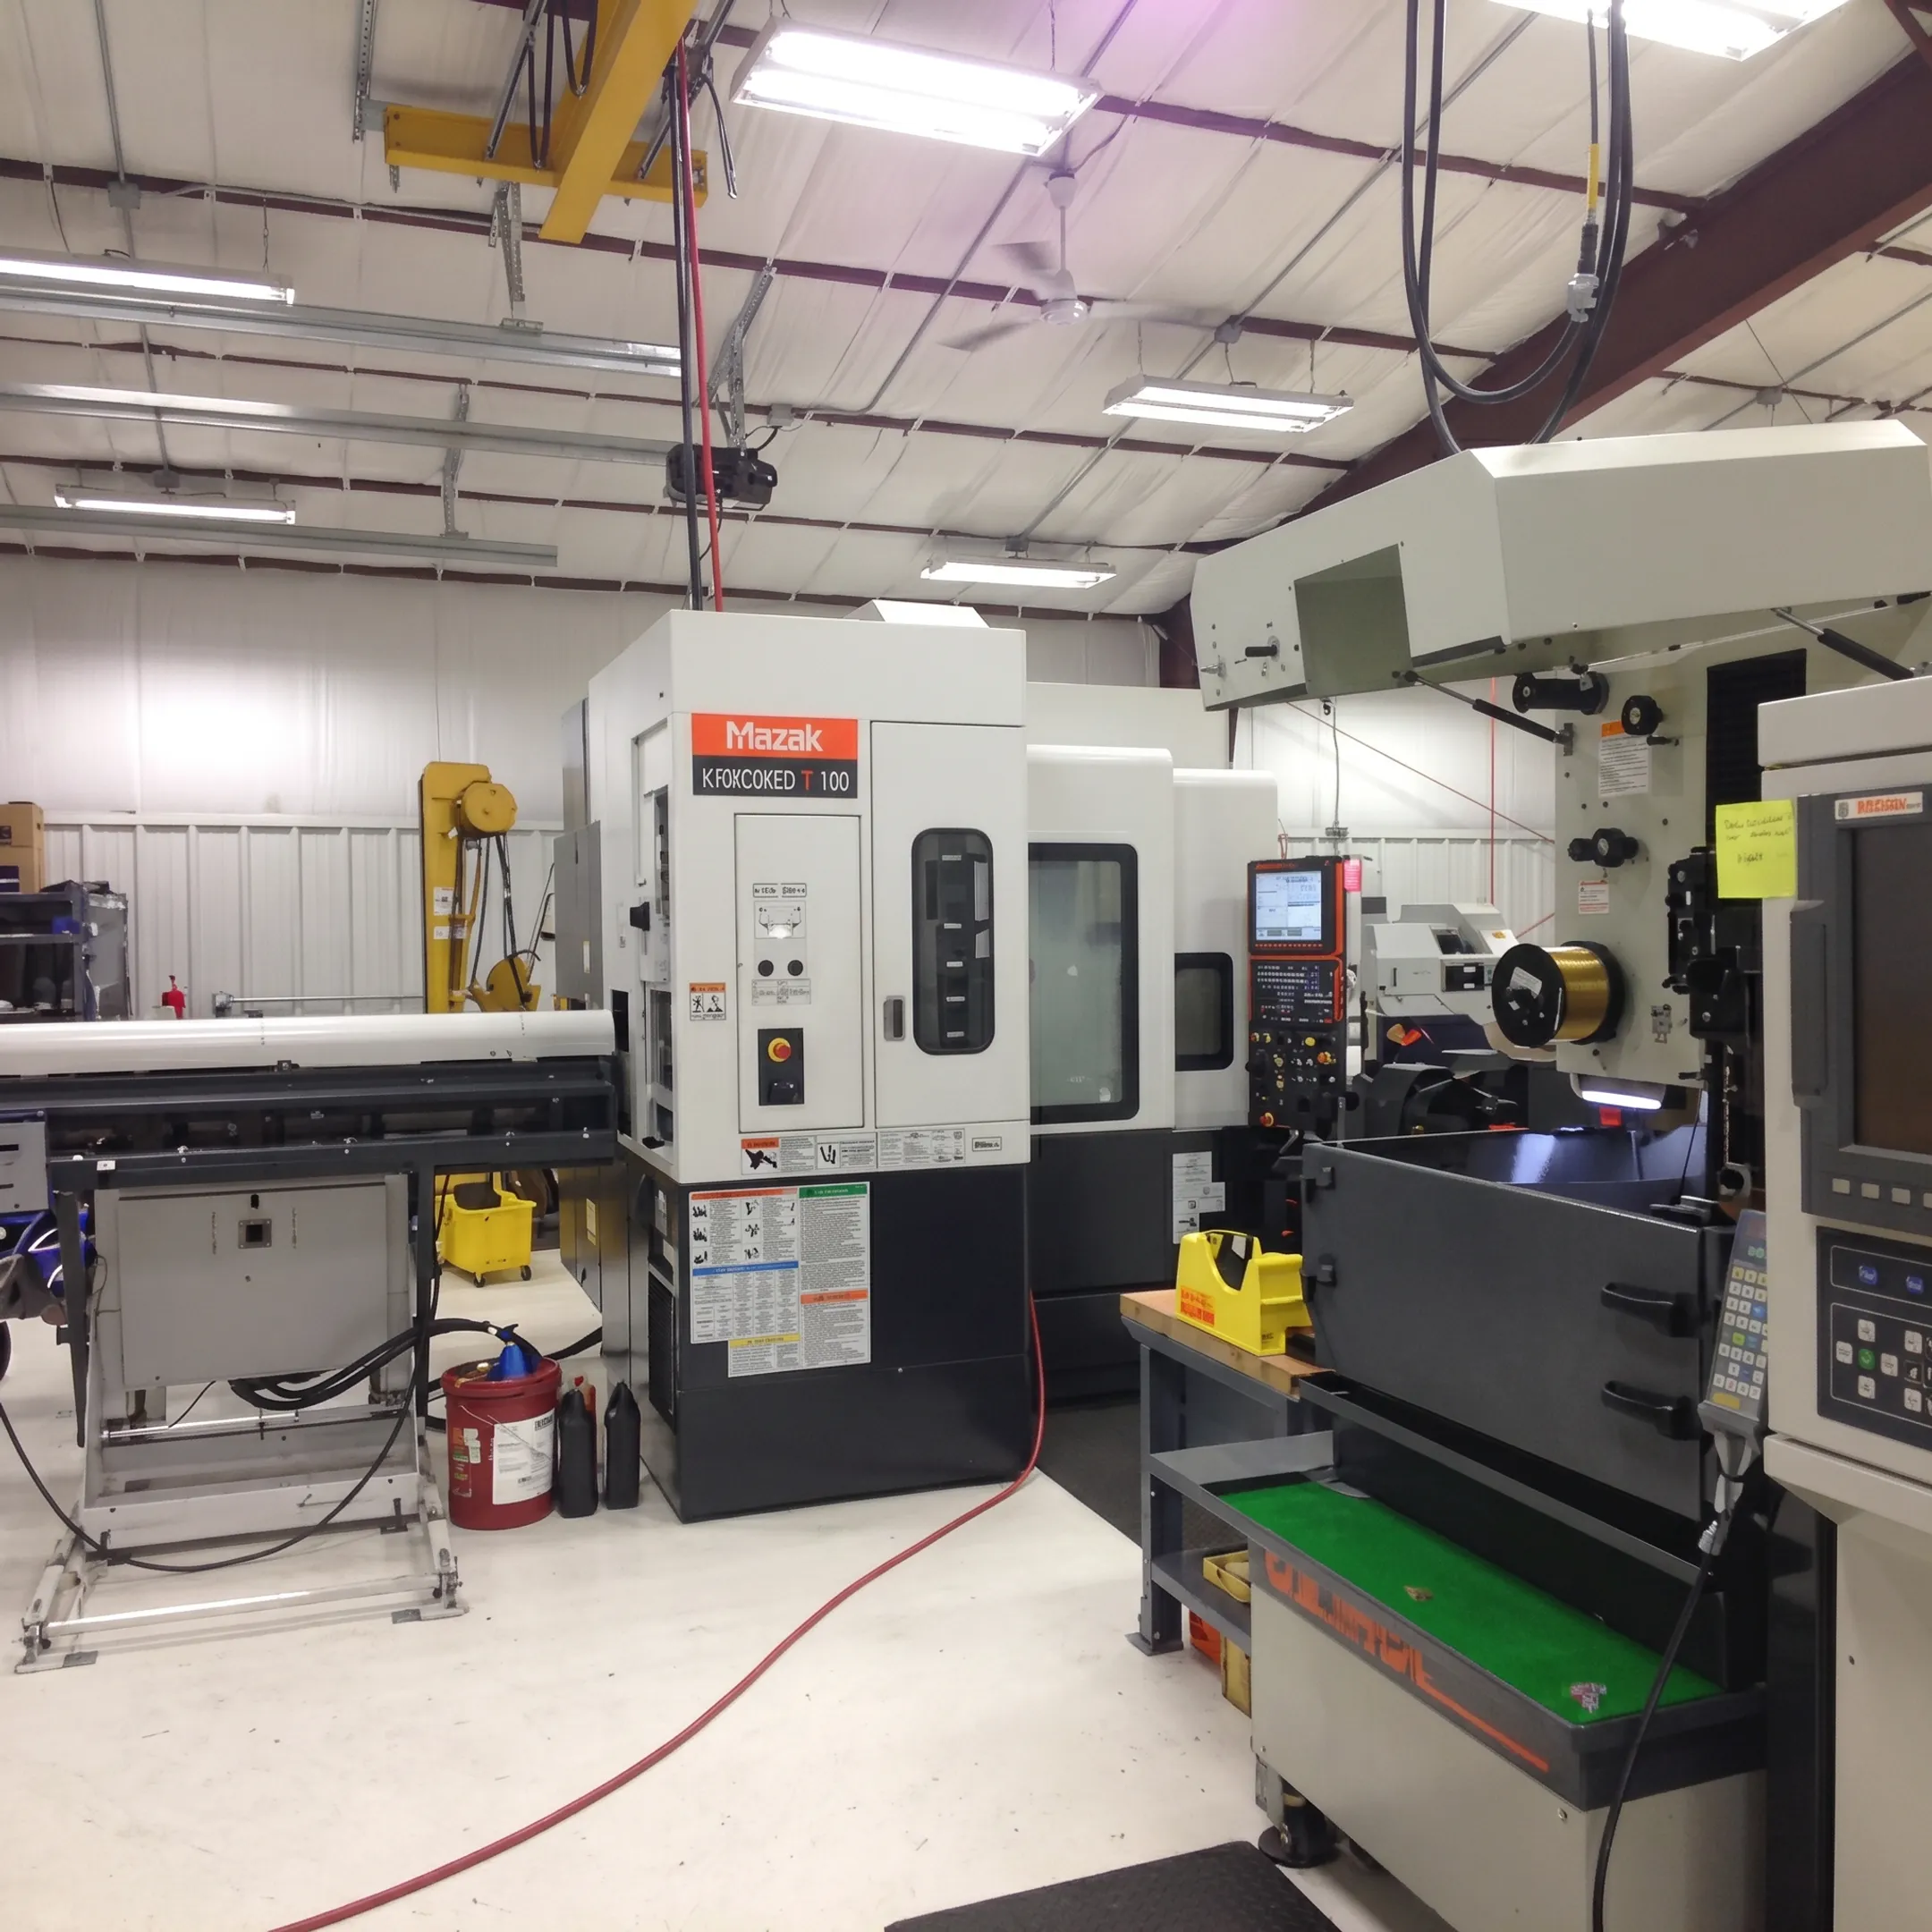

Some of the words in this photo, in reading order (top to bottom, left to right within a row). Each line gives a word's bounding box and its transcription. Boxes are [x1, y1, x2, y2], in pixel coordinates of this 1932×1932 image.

[726, 720, 824, 752] Mazak
[801, 769, 814, 791] T
[820, 770, 850, 792] 100
